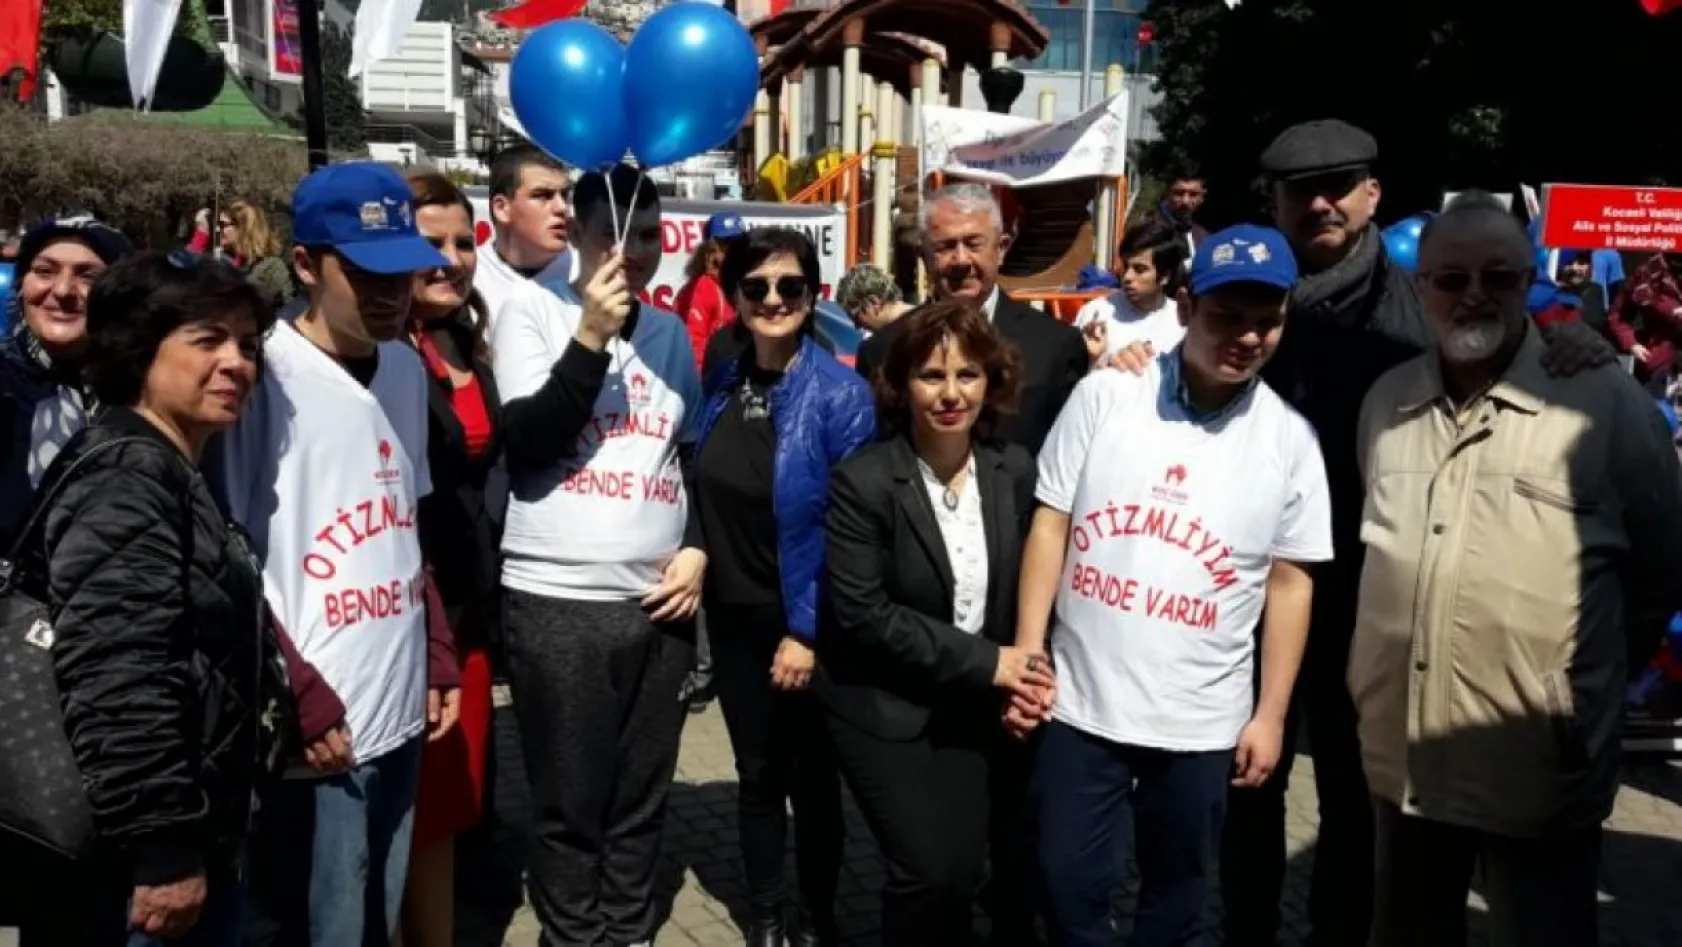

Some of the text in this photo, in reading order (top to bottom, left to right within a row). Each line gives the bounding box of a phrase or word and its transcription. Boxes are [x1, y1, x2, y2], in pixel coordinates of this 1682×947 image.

[324, 580, 402, 628] BENDE
[1072, 562, 1218, 632] BENDE VARIM
